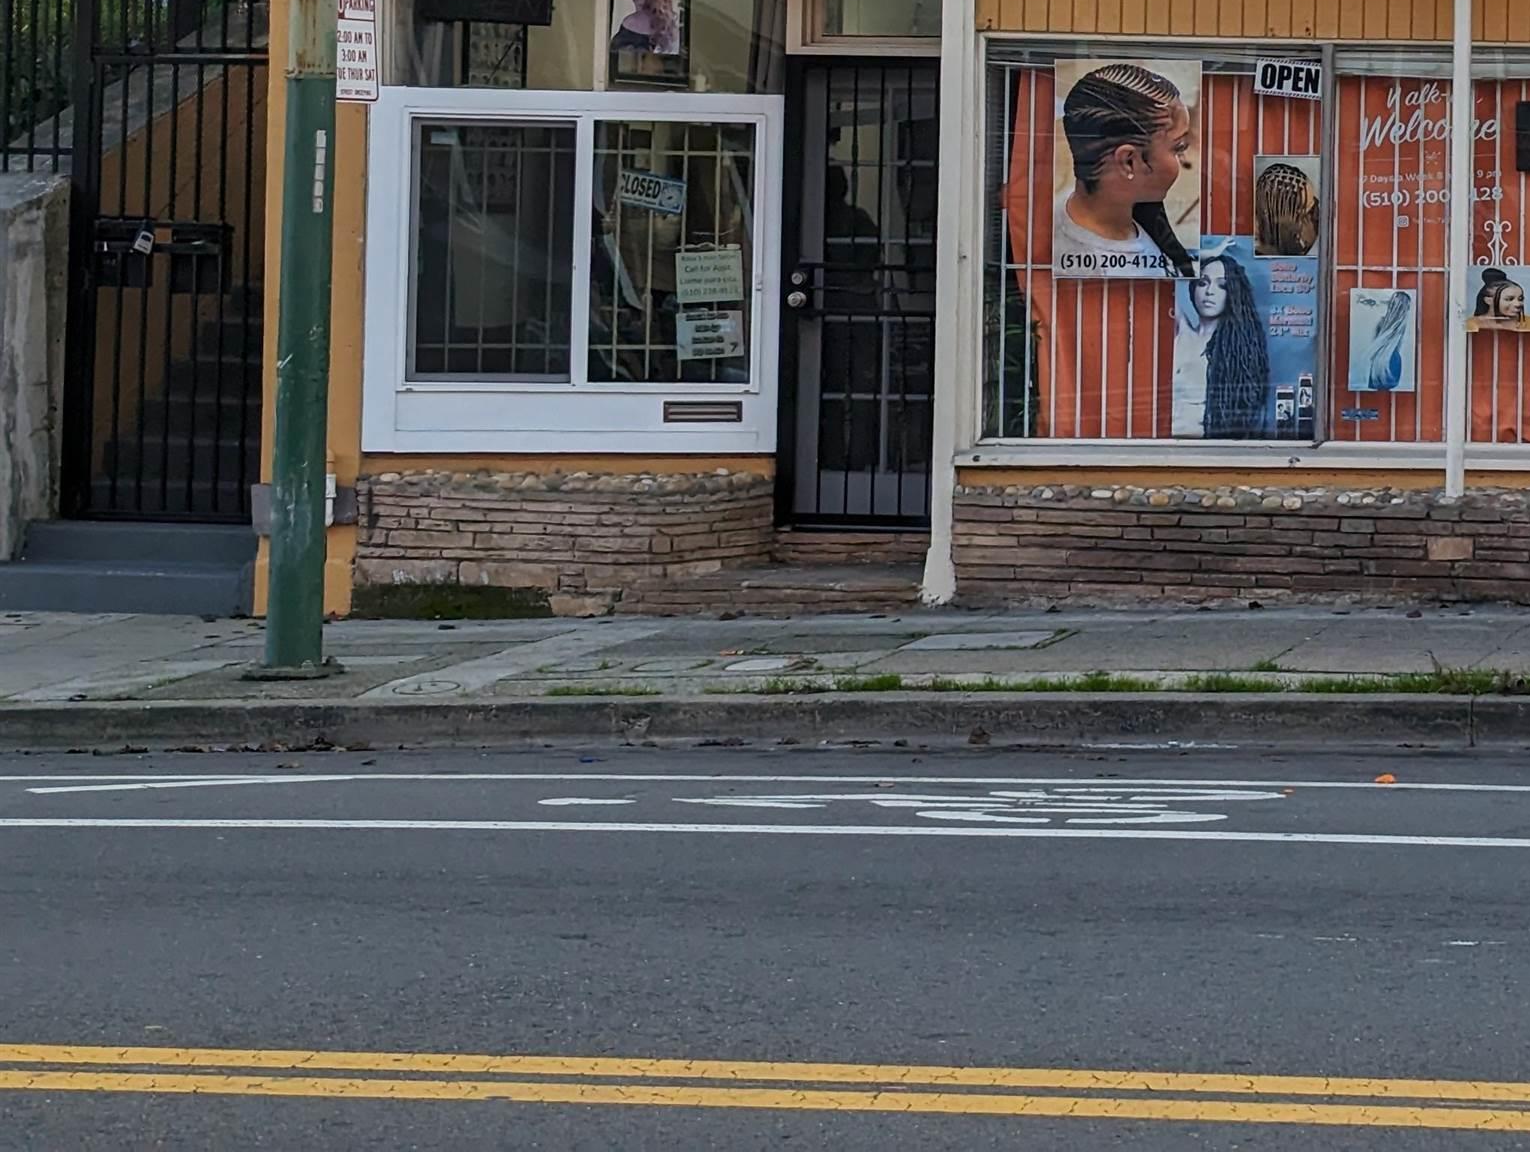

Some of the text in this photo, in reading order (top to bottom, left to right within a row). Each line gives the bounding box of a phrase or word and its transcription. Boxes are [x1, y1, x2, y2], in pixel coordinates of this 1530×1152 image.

[354, 32, 363, 43] AM
[365, 32, 372, 44] TO
[341, 49, 367, 62] 3:00 AM
[337, 67, 375, 81] UE THUR SAT
[1261, 63, 1321, 94] OPEN
[1360, 109, 1499, 151] Welcoe
[1361, 189, 1410, 208] (510)
[1061, 254, 1166, 269] (510) 200-4128
